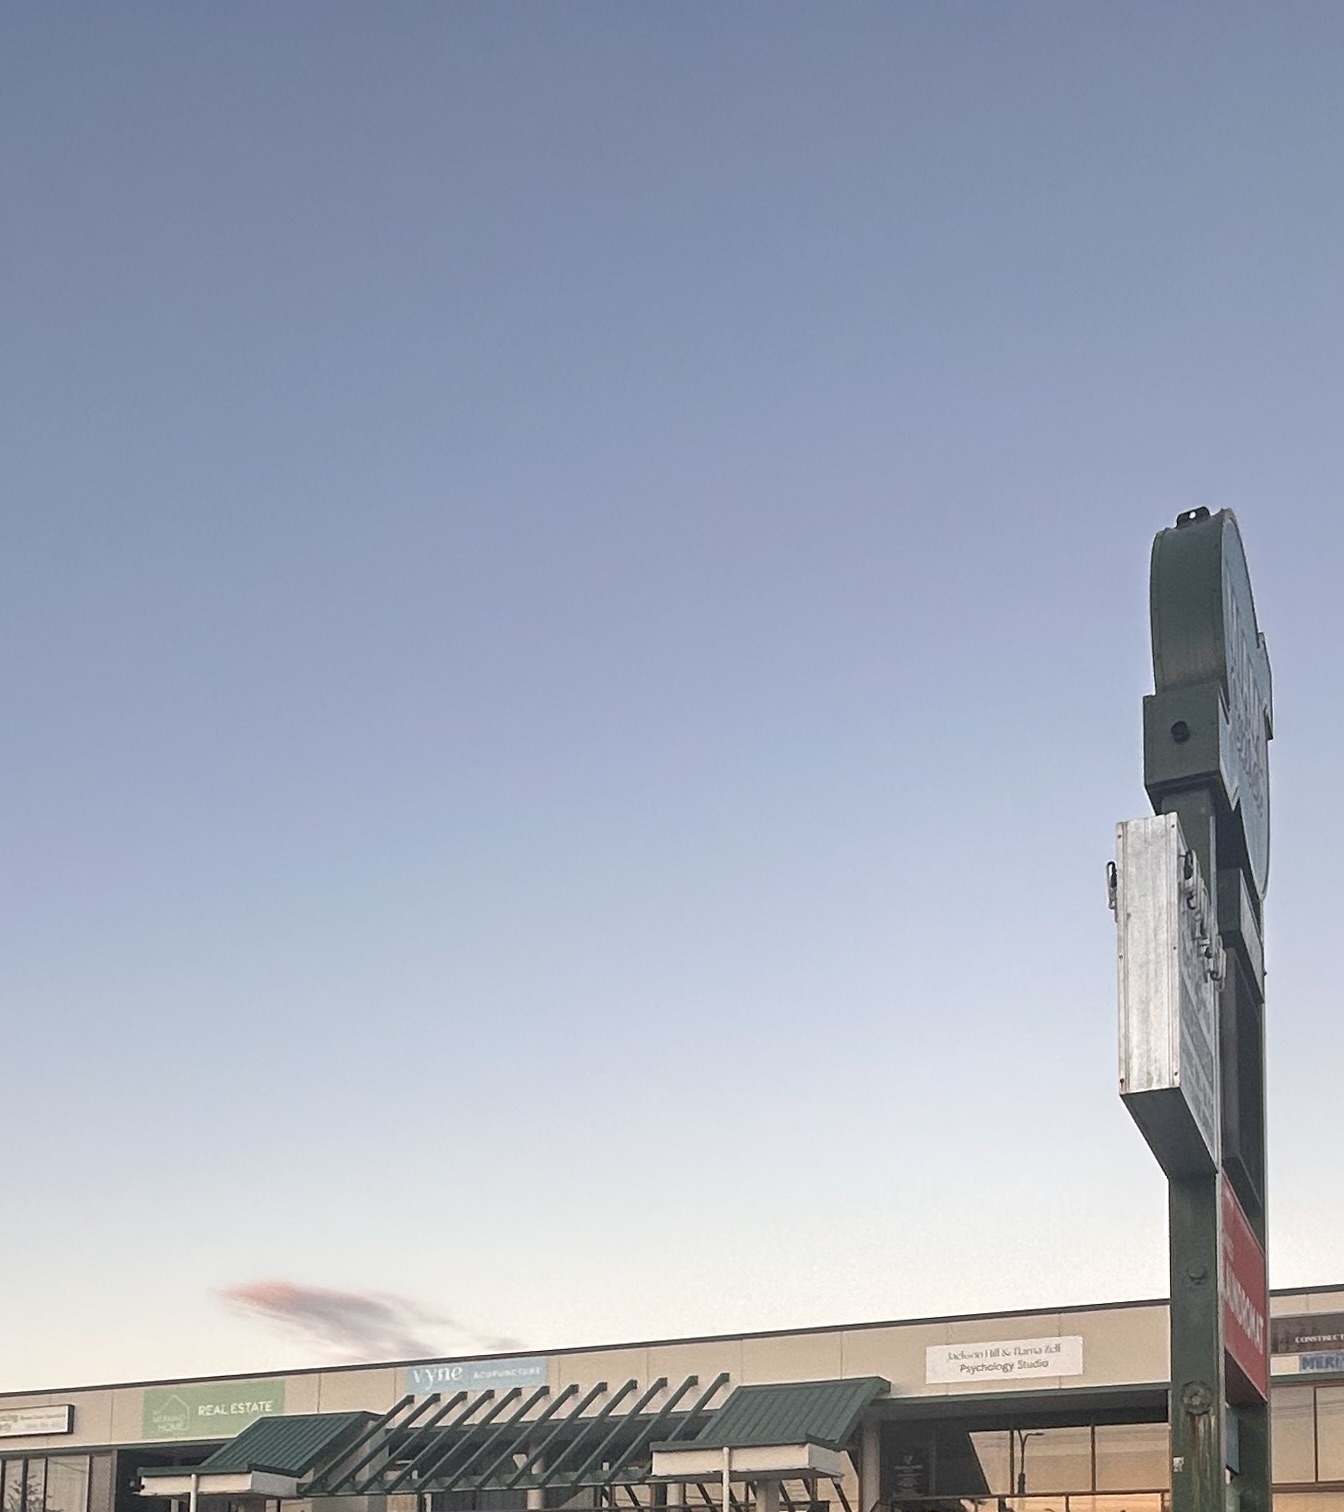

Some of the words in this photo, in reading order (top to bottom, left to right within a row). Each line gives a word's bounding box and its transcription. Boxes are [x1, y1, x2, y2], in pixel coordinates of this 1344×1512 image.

[960, 1362, 1014, 1375] Psychology
[1017, 1359, 1049, 1370] Studio
[413, 1366, 463, 1391] vyne
[473, 1367, 542, 1379] ACUPUNCTURE
[198, 1404, 229, 1416] REAL
[230, 1400, 273, 1414] ESTATE
